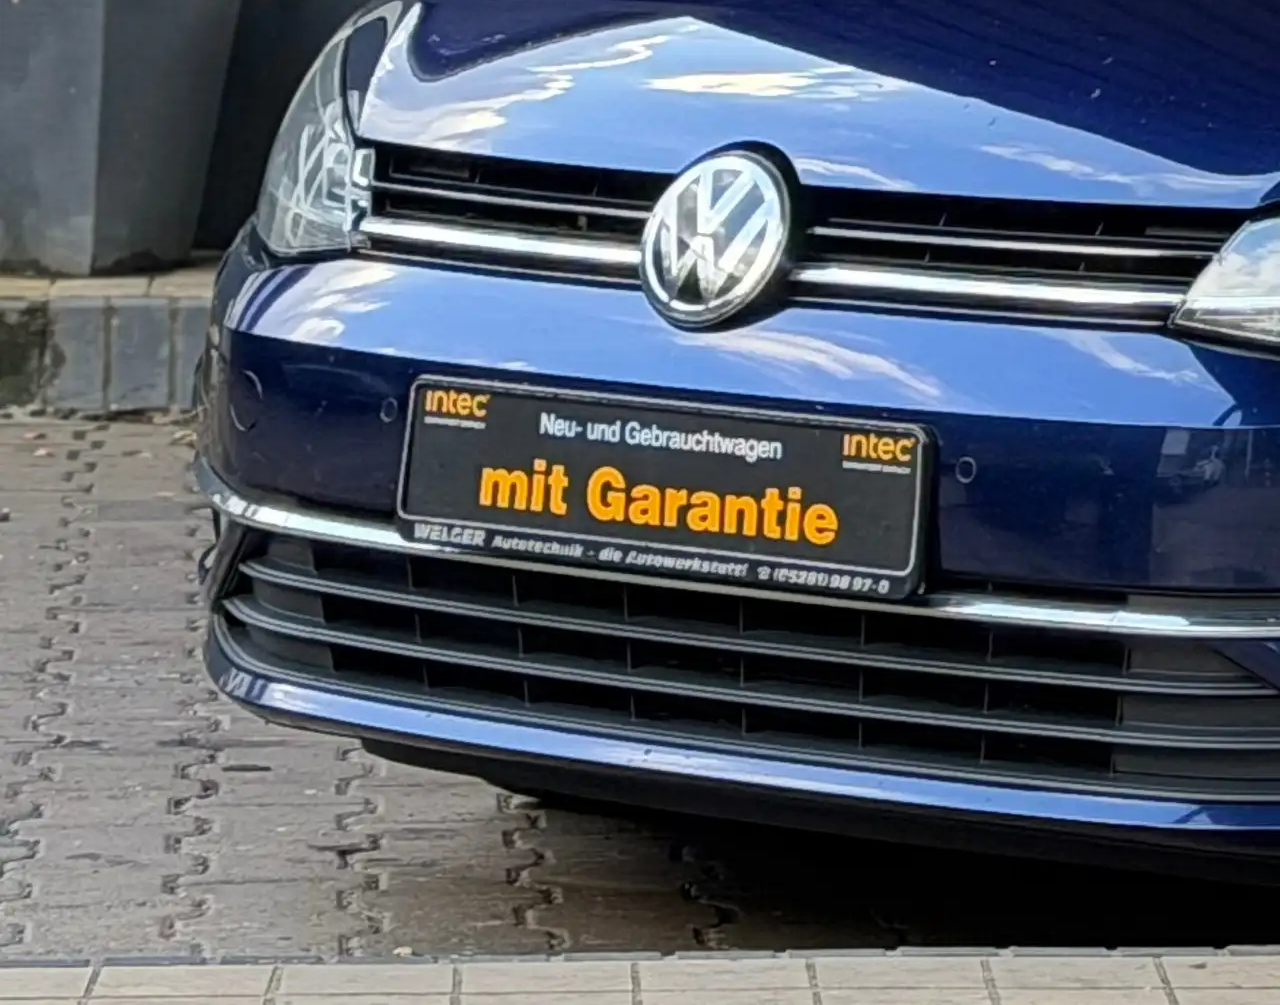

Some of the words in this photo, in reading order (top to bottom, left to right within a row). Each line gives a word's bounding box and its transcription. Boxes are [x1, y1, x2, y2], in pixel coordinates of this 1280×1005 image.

[424, 389, 491, 418] intec
[539, 411, 583, 438] Neu-
[586, 420, 621, 442] und
[624, 421, 783, 463] Gebrauchtwagen
[842, 432, 916, 462] intec
[478, 457, 569, 516] mit
[586, 465, 840, 547] Garantie
[413, 522, 486, 547] WELGER
[491, 535, 584, 558] Autotechnik
[598, 546, 623, 563] die
